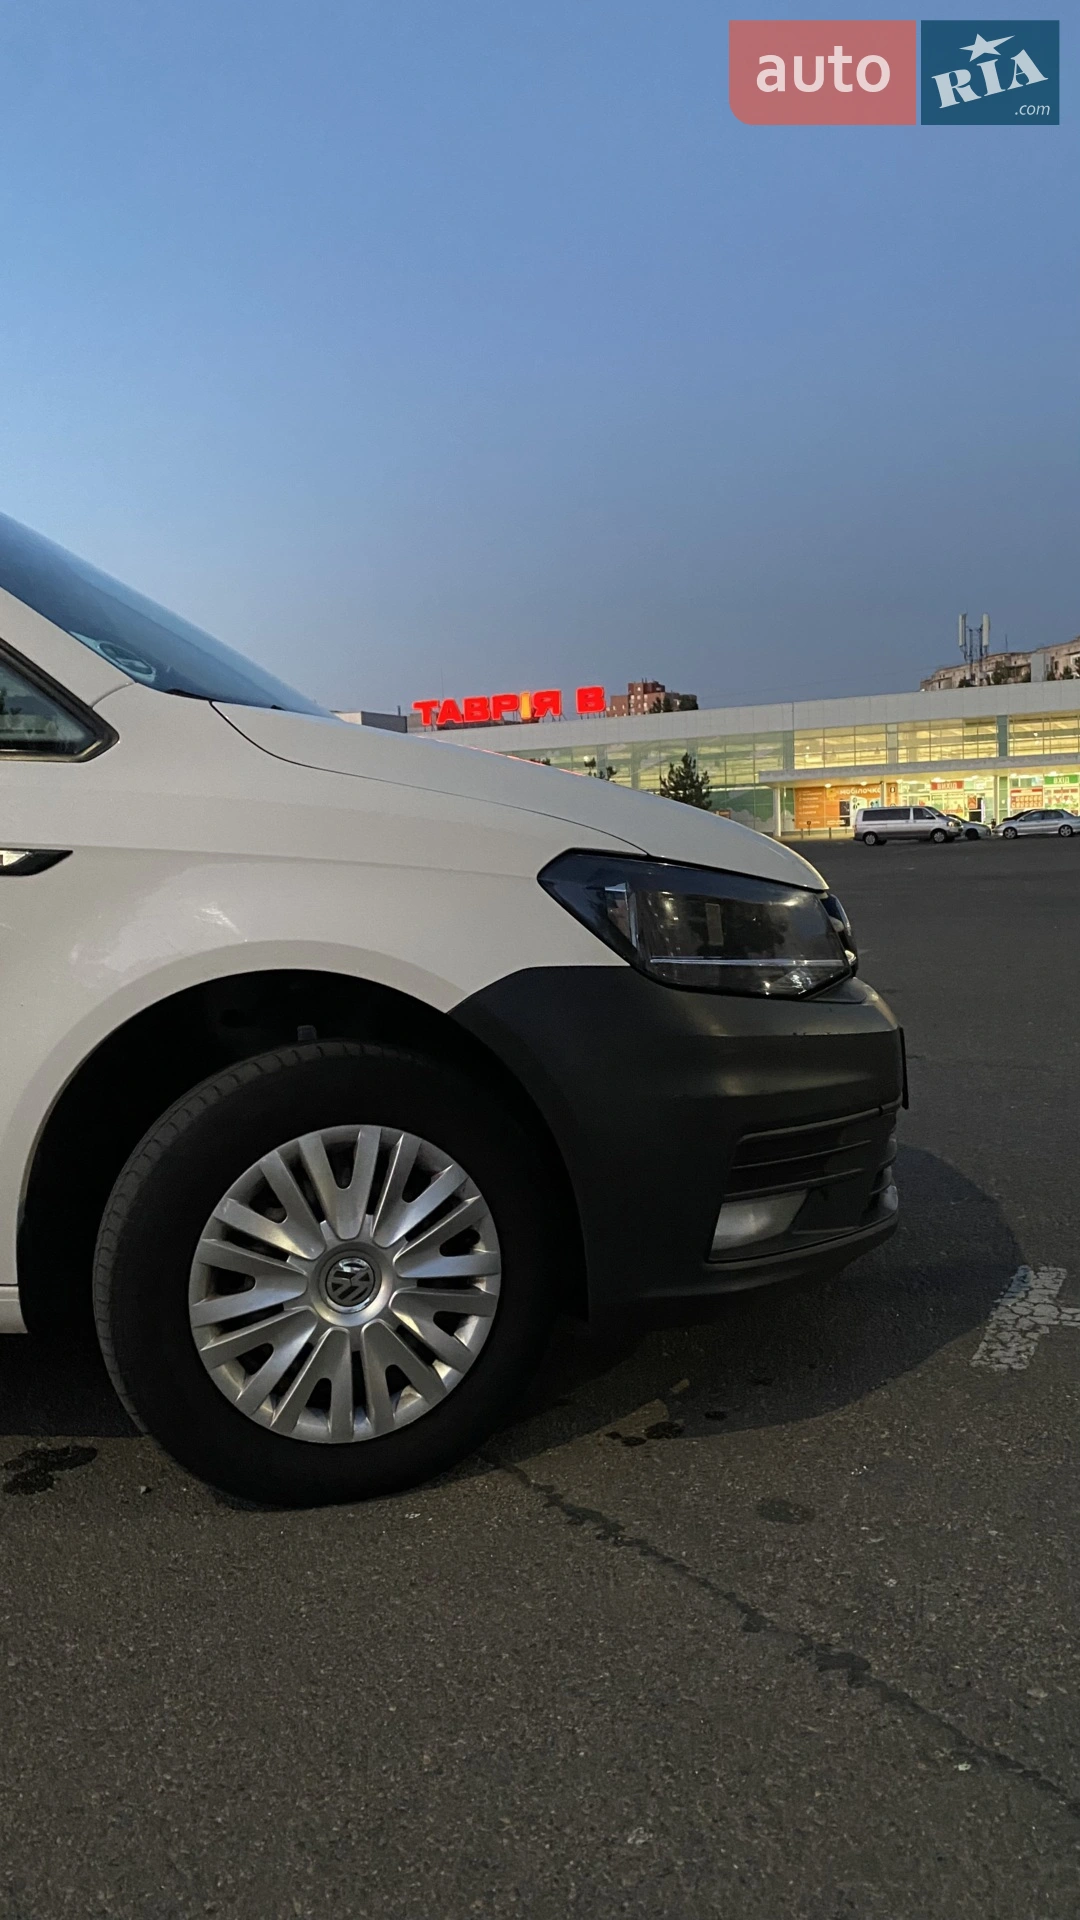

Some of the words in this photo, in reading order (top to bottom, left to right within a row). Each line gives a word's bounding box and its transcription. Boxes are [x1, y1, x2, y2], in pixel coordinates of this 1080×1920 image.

[412, 690, 562, 727] ТАВРІЯ
[576, 686, 606, 714] В
[937, 782, 957, 790] ВИХІД
